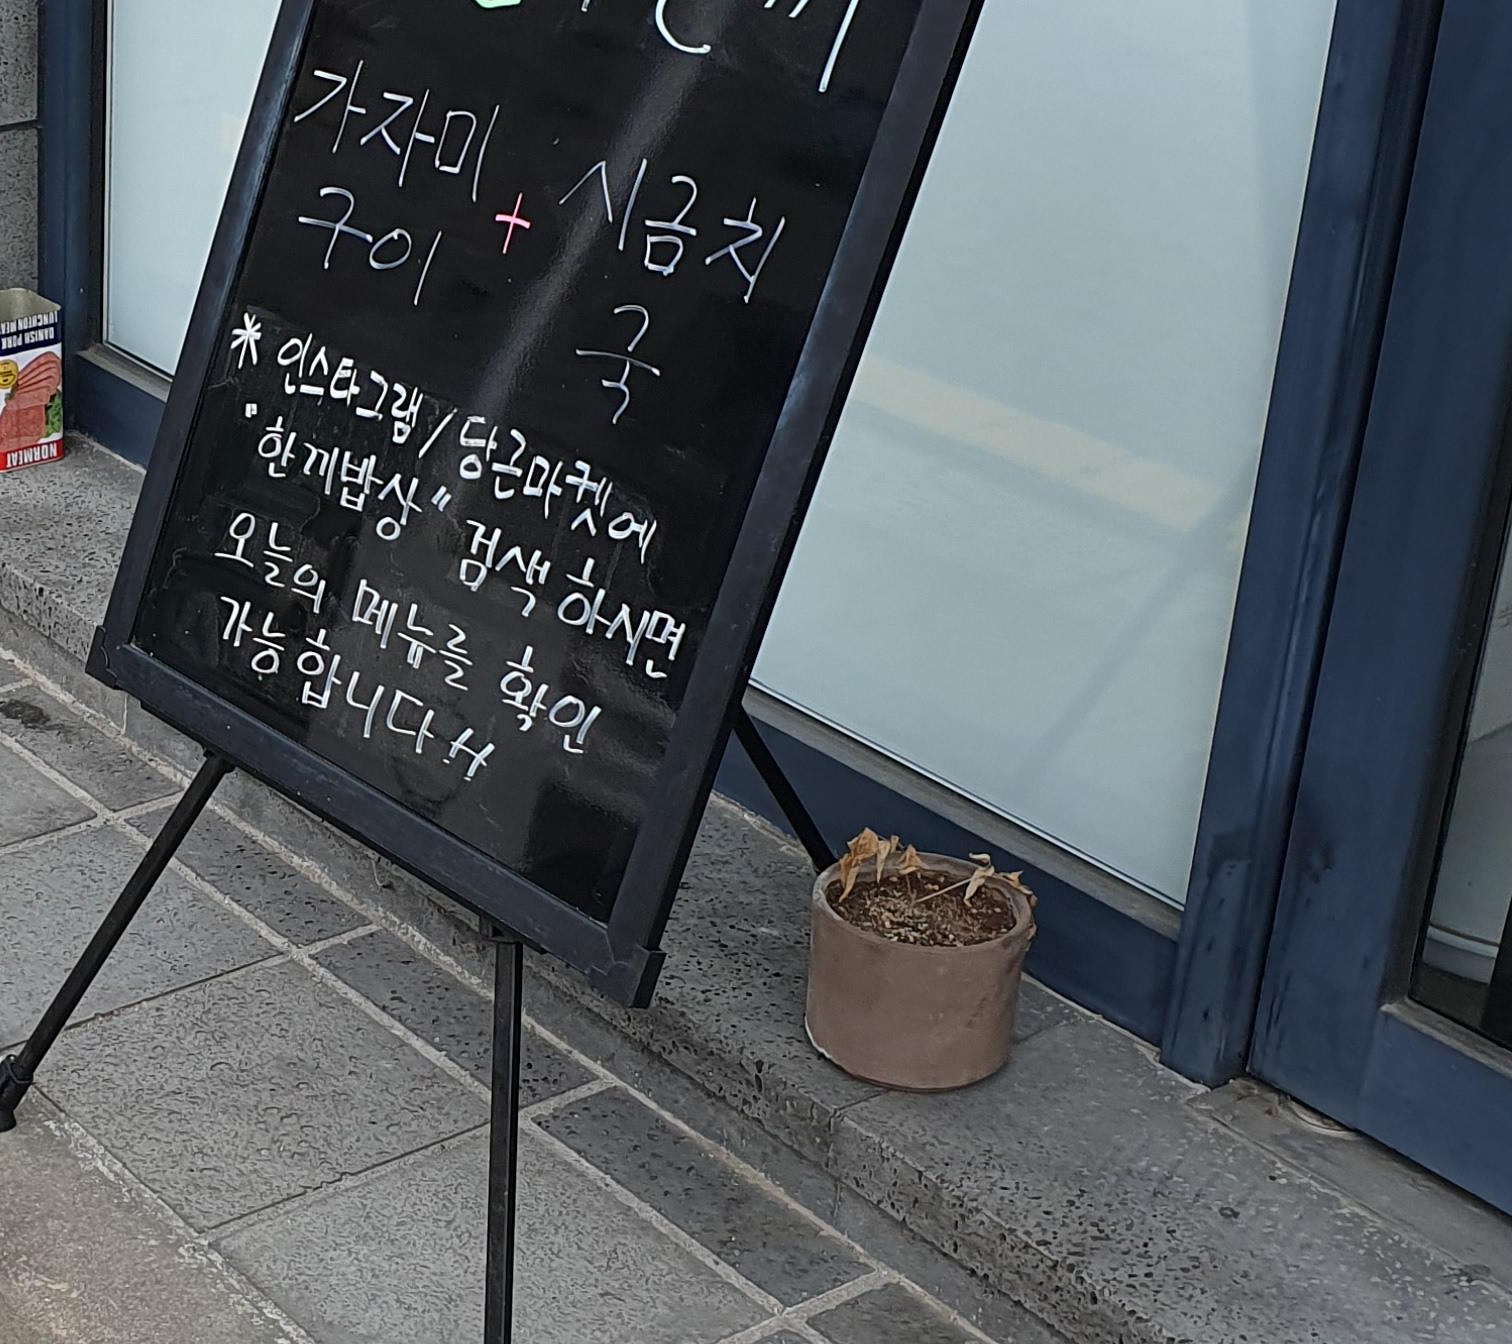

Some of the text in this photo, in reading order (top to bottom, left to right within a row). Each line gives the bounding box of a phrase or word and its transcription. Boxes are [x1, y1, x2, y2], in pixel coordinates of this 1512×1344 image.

[294, 60, 500, 203] 가자미
[298, 187, 443, 306] 구이
[559, 158, 786, 304] 시금치
[1, 326, 55, 350] DANISH PORK
[576, 304, 660, 425] 국
[6, 442, 57, 468] NORMEAT
[214, 512, 601, 755] 오늘의 메뉴를 확인
